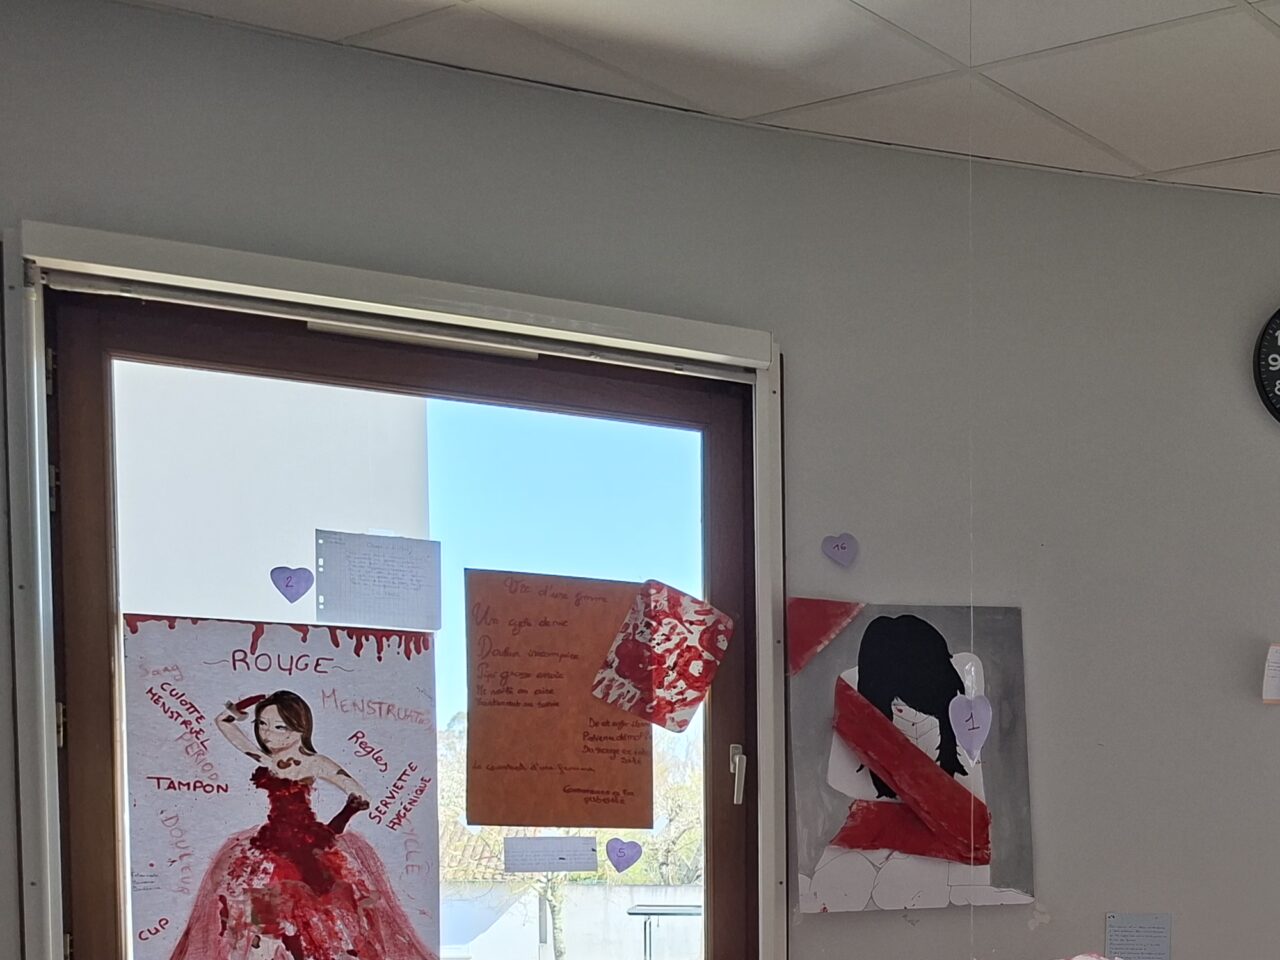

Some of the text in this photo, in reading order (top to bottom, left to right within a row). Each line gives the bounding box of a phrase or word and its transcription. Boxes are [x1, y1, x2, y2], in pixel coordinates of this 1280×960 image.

[285, 575, 295, 588] 2
[231, 648, 335, 676] ROUGE
[145, 686, 210, 752] MENSTRUEL
[964, 711, 980, 731] 1
[145, 775, 229, 794] TAMPON
[369, 761, 418, 825] SERVIETTE
[138, 917, 170, 942] CUP
